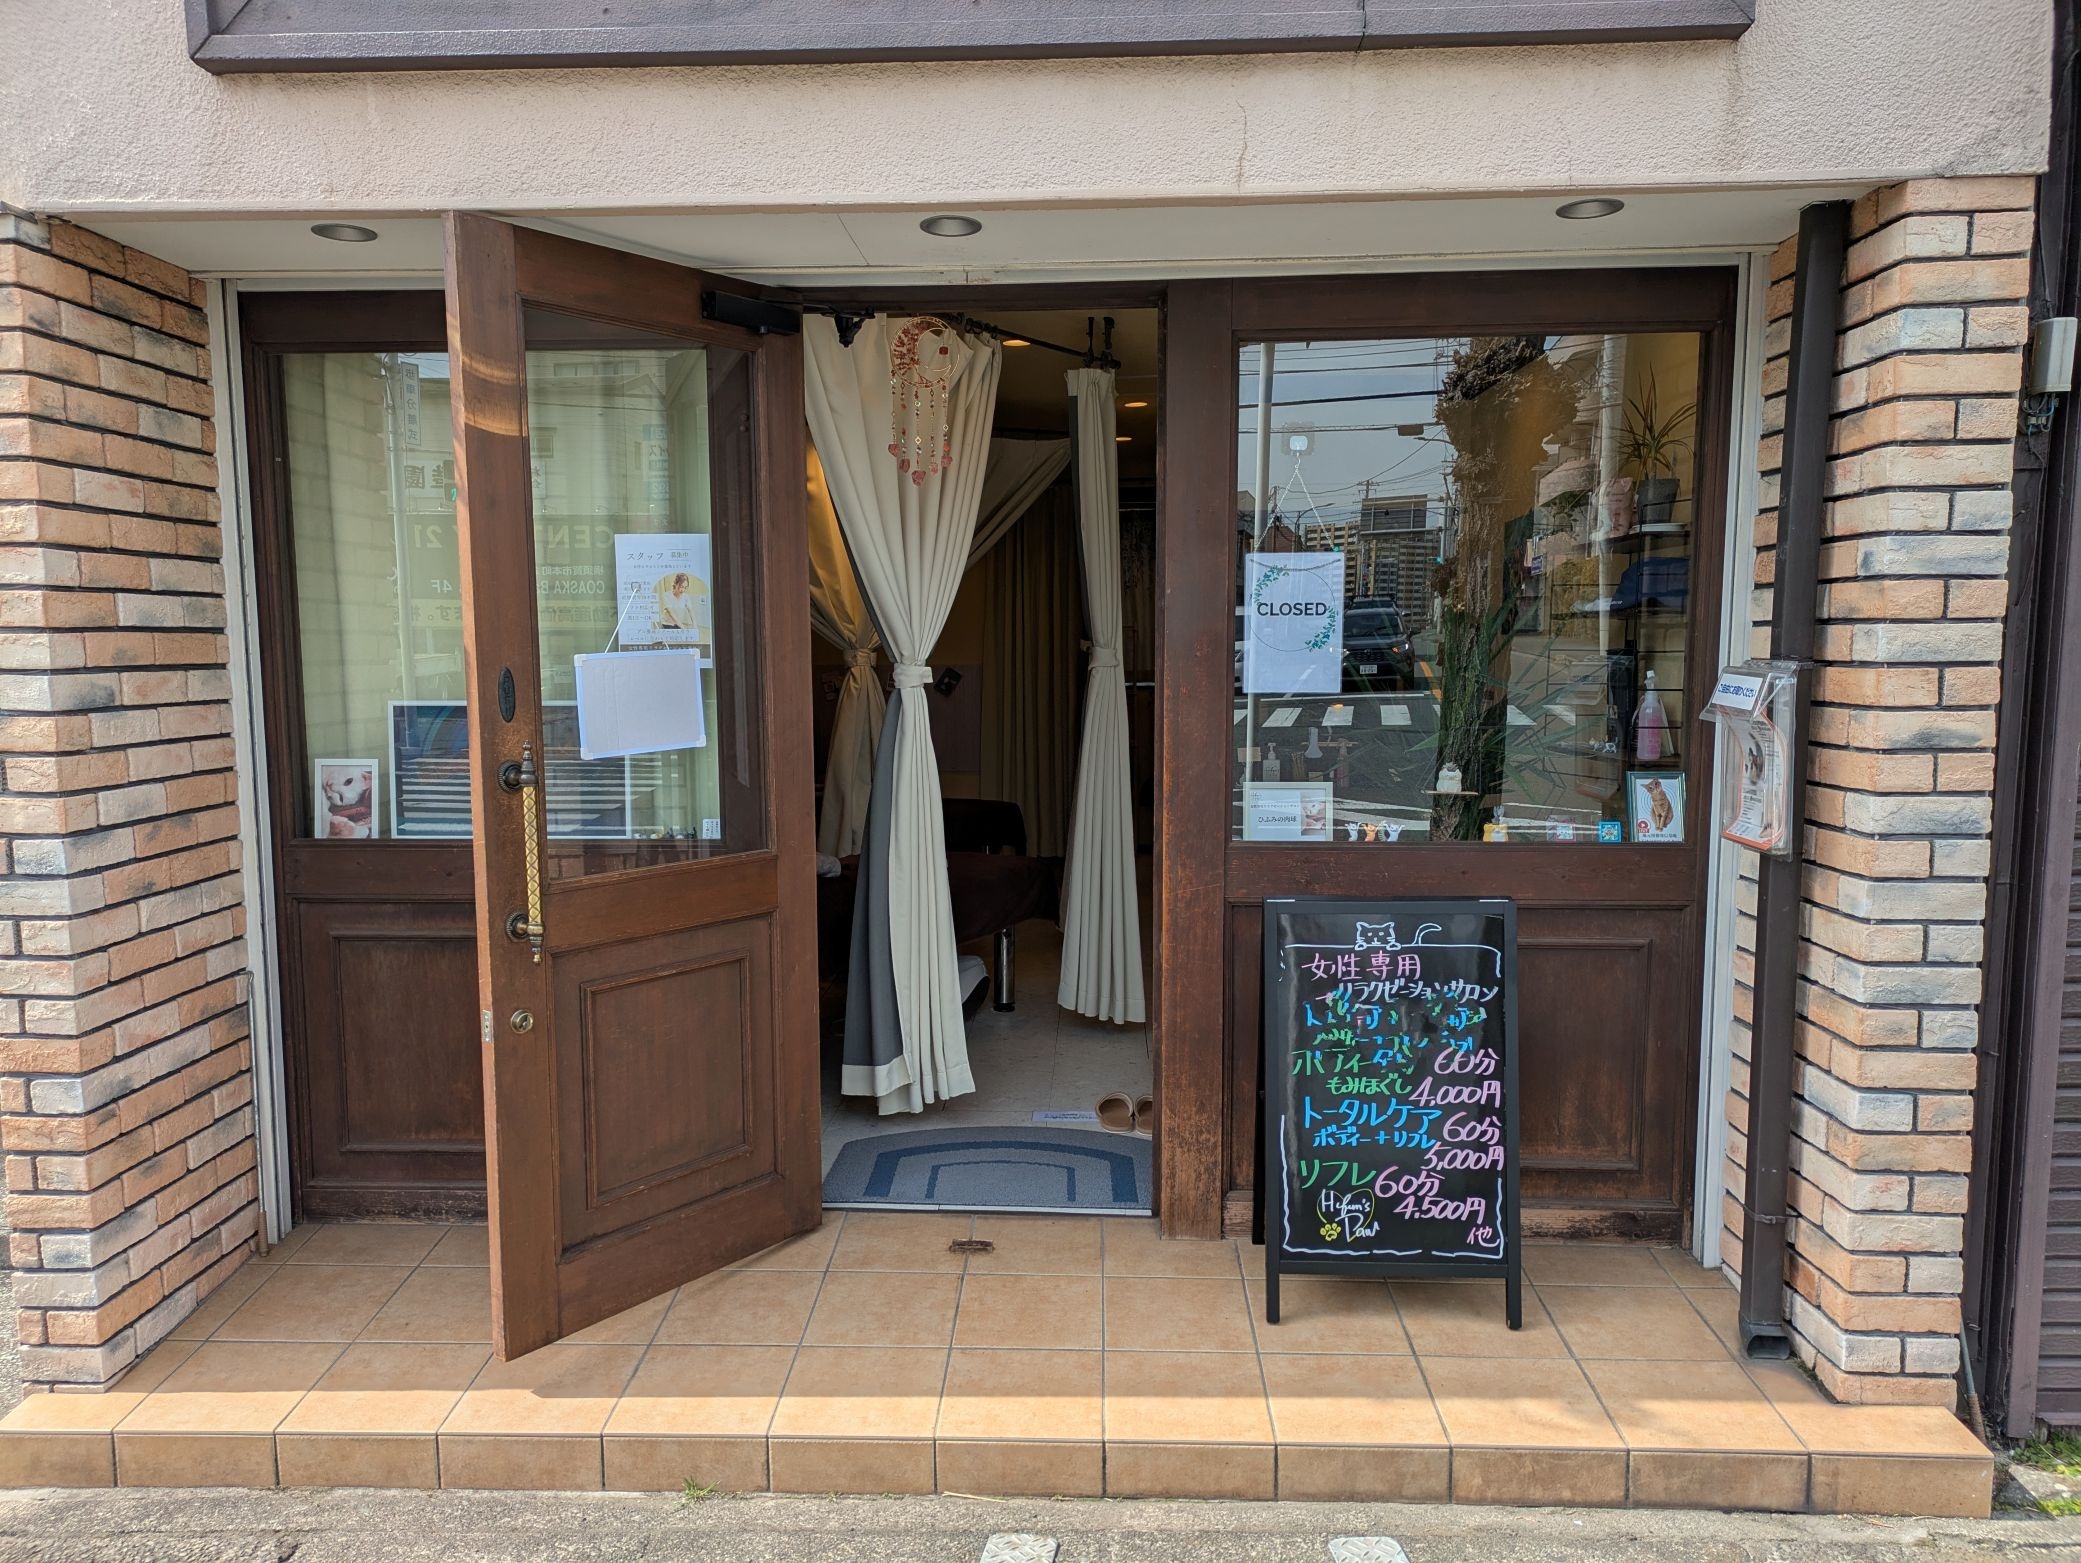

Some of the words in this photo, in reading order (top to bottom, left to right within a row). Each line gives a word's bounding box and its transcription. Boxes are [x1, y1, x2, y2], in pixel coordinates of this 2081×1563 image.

[1257, 602, 1328, 616] CLOSED
[1258, 815, 1297, 823] ひふみの肉球
[1301, 950, 1421, 980] 女性専用
[1325, 1072, 1412, 1096] もみほぐし
[1304, 1096, 1442, 1134] トータルケア
[1442, 1111, 1502, 1145] 60分
[1300, 1159, 1377, 1189] リフレ
[1374, 1165, 1446, 1198] 60分
[1466, 1226, 1500, 1248] 他
